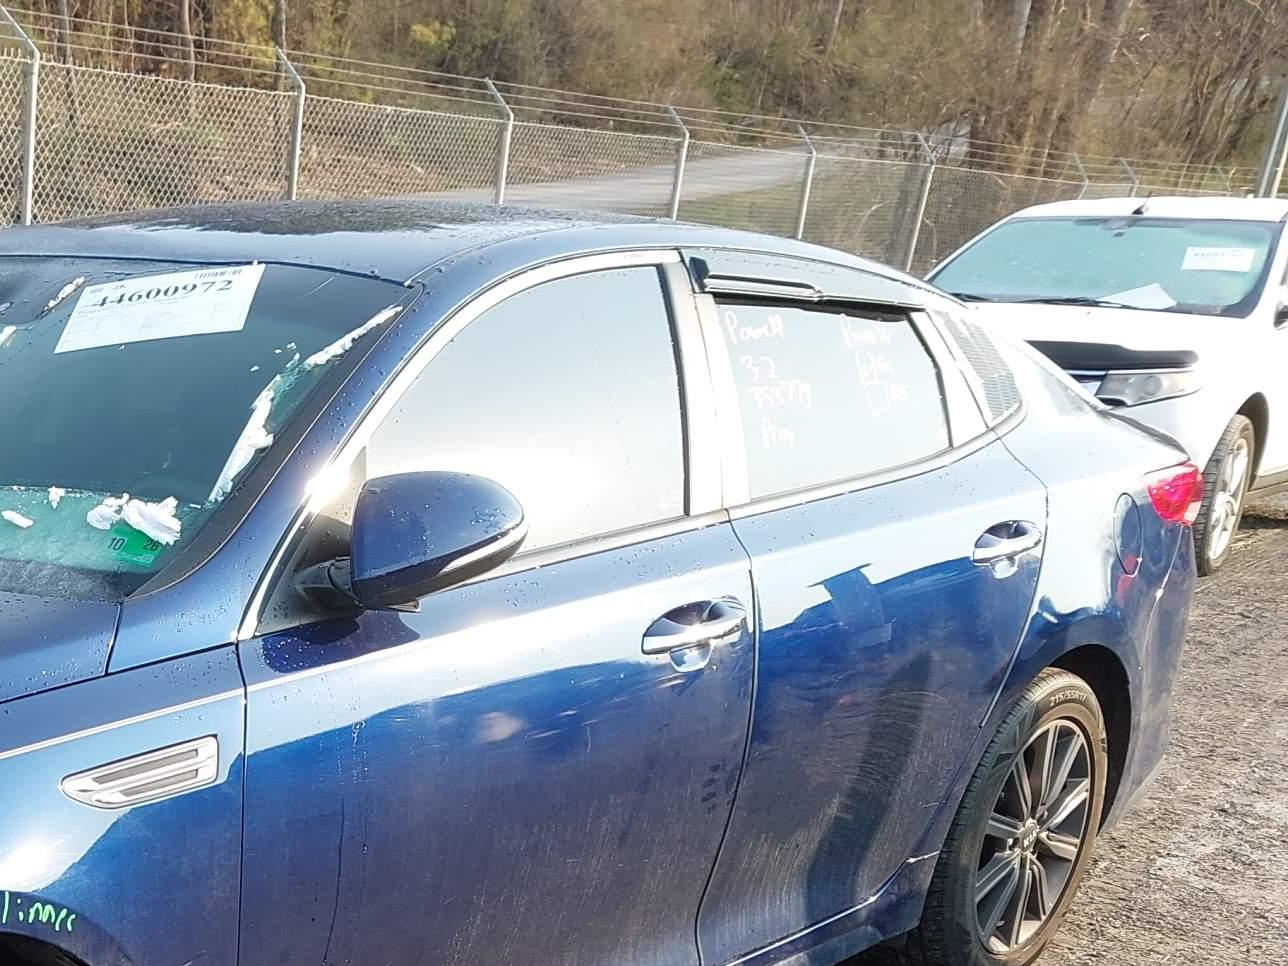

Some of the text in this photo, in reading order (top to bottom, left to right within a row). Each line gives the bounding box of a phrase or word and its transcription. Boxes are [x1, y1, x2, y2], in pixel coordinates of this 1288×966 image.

[89, 279, 232, 307] 44600972
[740, 354, 777, 383] 32
[108, 537, 126, 551] 10
[1049, 689, 1088, 708] 215/55R17
